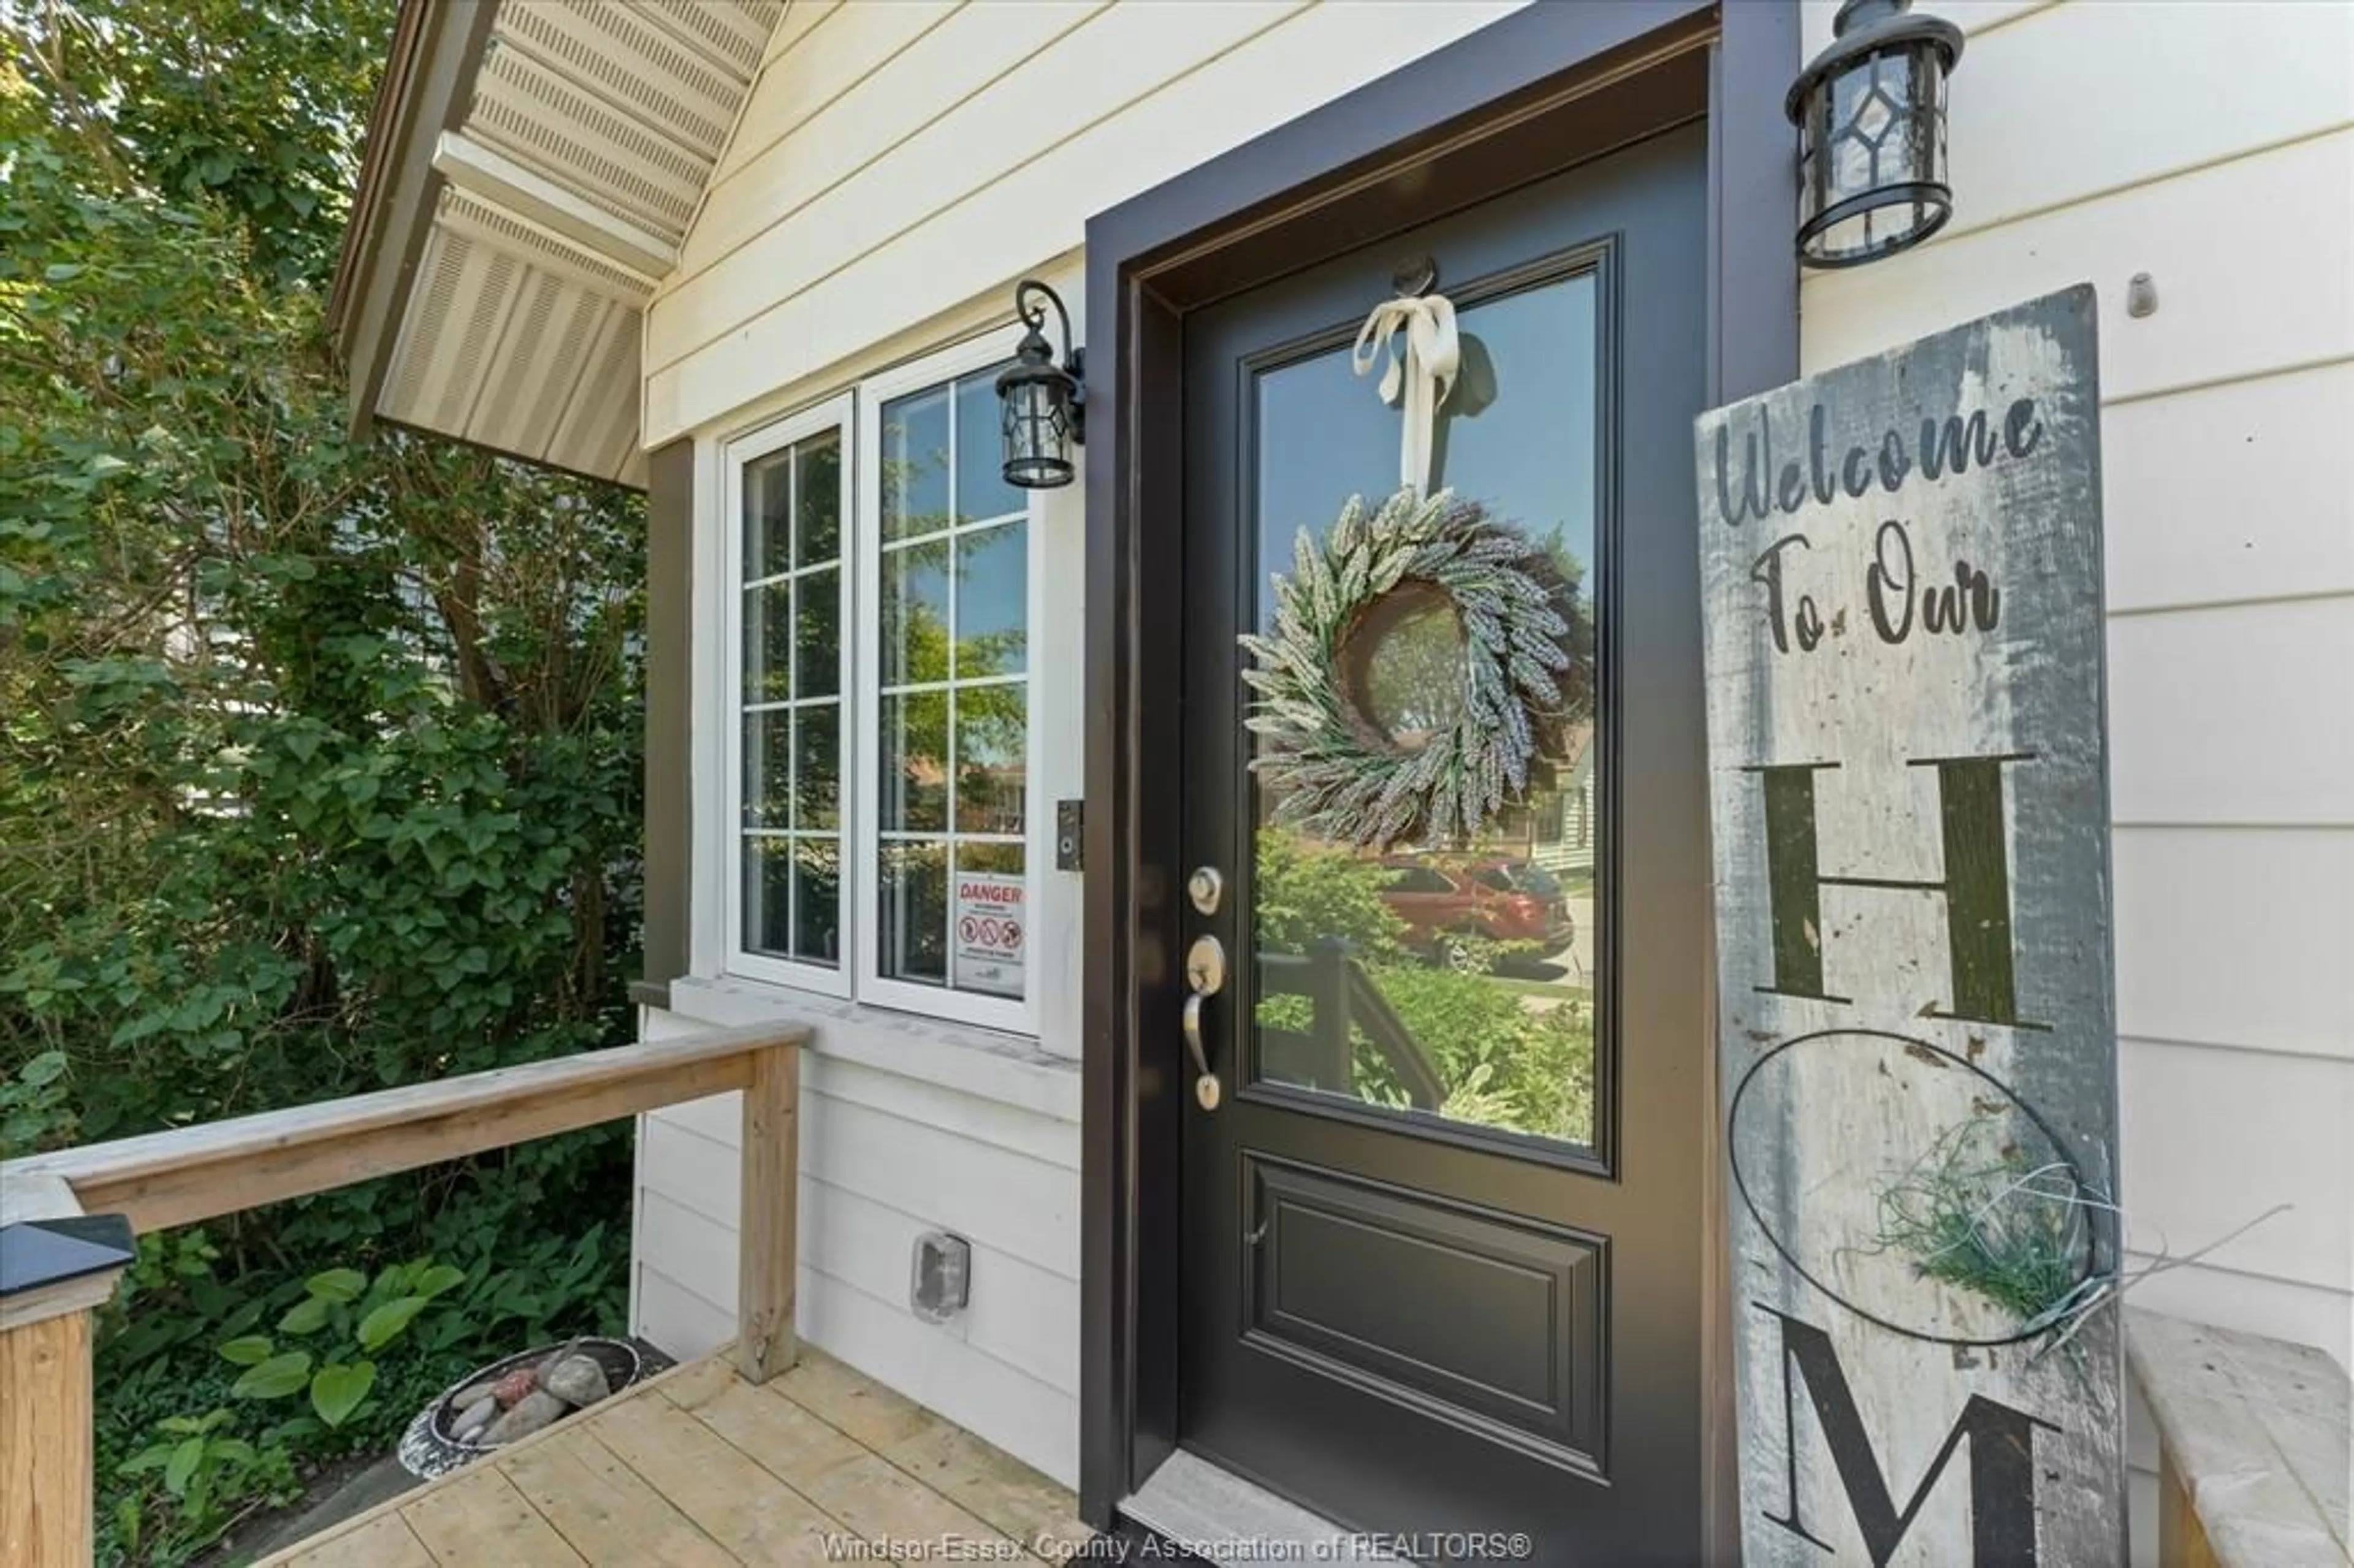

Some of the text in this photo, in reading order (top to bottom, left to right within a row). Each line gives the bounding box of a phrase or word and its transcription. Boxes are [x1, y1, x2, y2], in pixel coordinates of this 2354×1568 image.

[1716, 398, 2043, 527] Welcome
[1750, 520, 2000, 653] To Our
[960, 883, 1023, 902] DANGER
